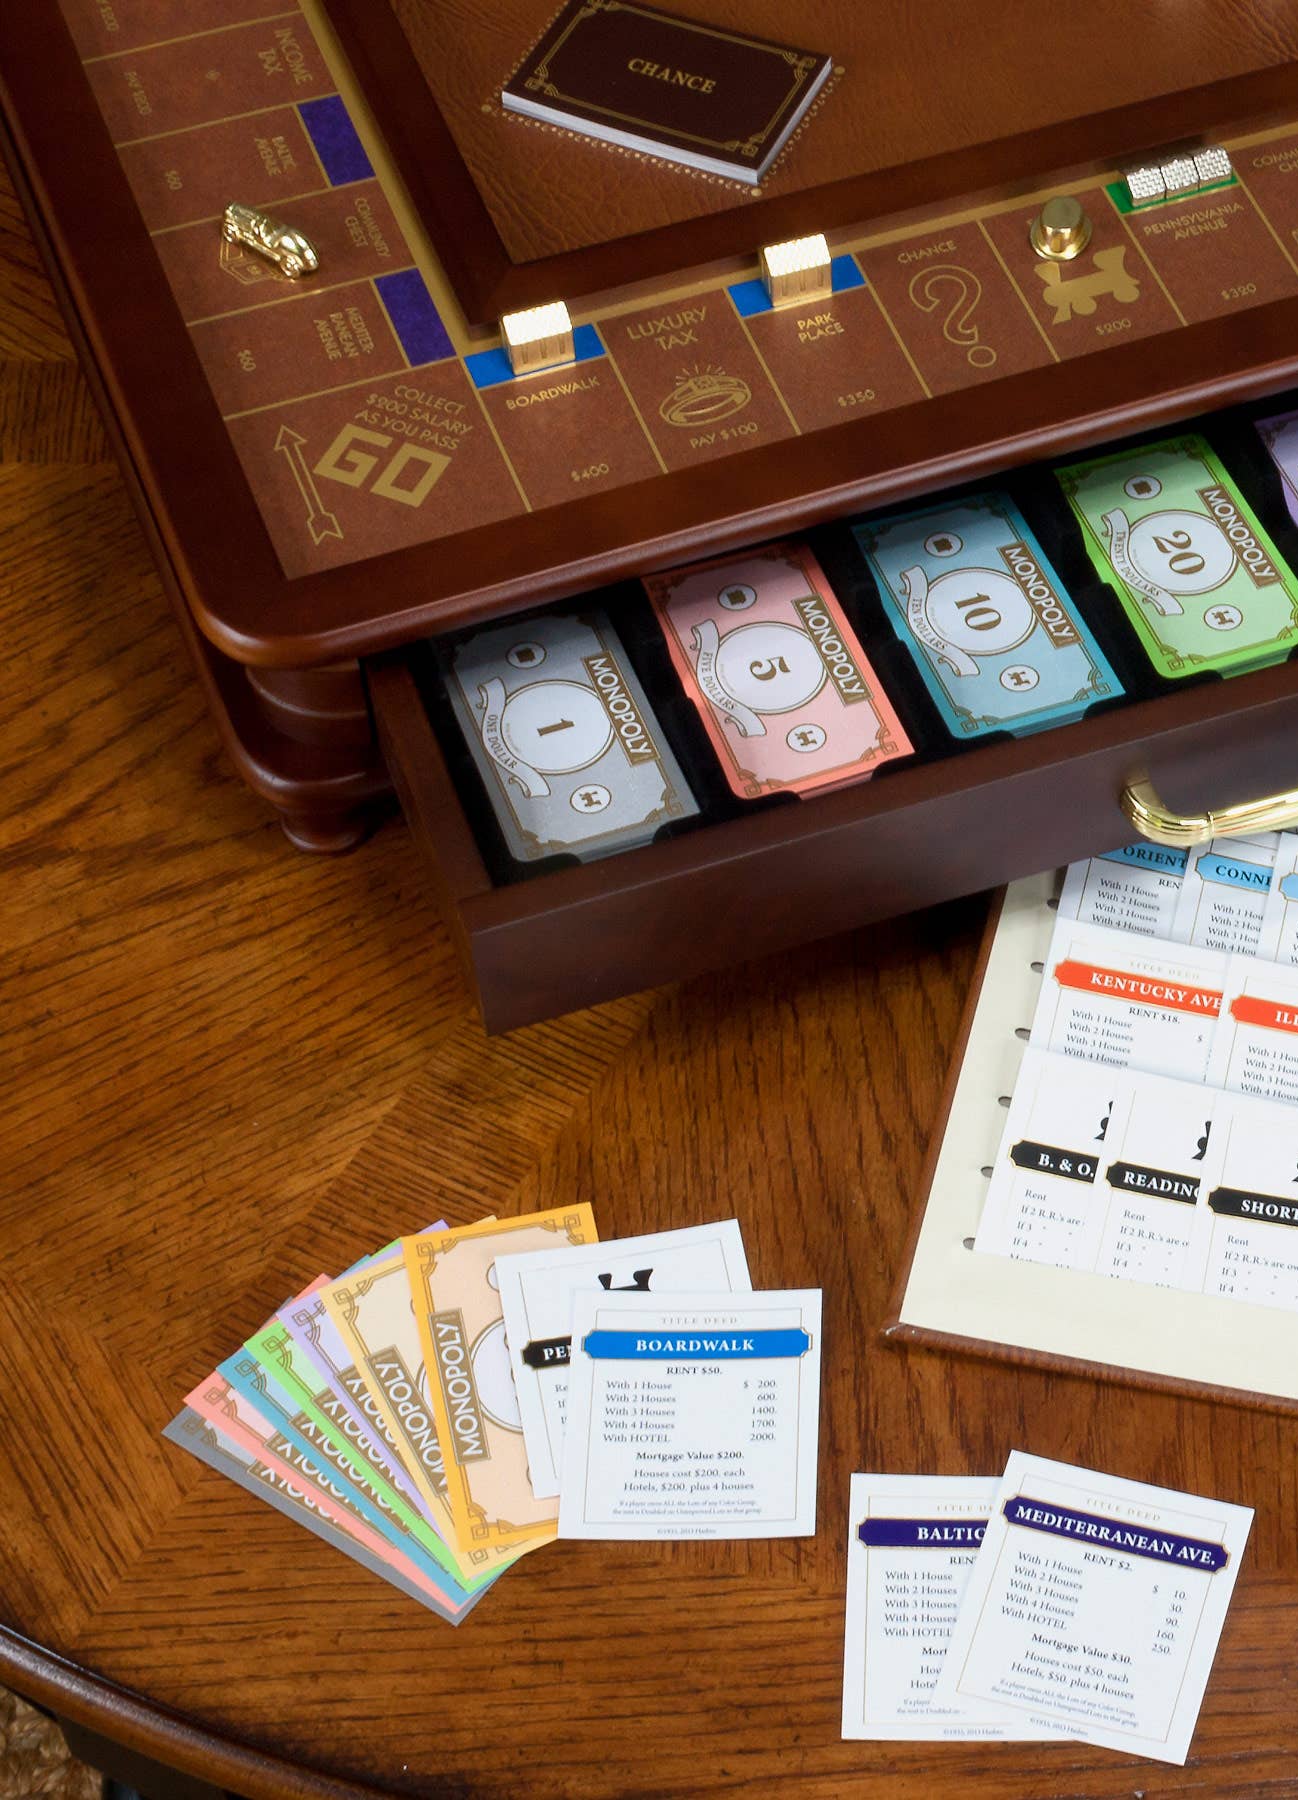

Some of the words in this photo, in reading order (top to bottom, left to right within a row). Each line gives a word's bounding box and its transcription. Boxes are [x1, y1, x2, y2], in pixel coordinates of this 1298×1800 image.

[258, 48, 283, 76] TAX
[274, 27, 312, 84] INCOME
[627, 57, 716, 95] CHANCE
[1143, 202, 1244, 236] PENNSYLVANIA
[1173, 220, 1228, 240] AVENUE
[897, 239, 957, 265] CHANCE
[1220, 283, 1257, 301] $320
[626, 306, 708, 341] LUXURY
[796, 311, 835, 331] PARK
[798, 321, 845, 344] PLACE
[1095, 318, 1132, 336] $200
[655, 329, 698, 351] TAX
[393, 384, 466, 416] COLLECT
[506, 376, 600, 410] BOARDWALK
[837, 389, 876, 408] $350
[366, 393, 407, 416] $200
[411, 407, 473, 435] SALARY
[354, 409, 378, 424] AS
[382, 414, 418, 437] YOU
[419, 429, 460, 450] PASS
[689, 432, 717, 449] PAY
[720, 421, 759, 441] $100
[313, 423, 452, 508] GO
[570, 463, 610, 482] $400
[1204, 489, 1276, 578] MONOPOLY
[1152, 530, 1205, 575] 20
[1005, 547, 1075, 639] MONOPOLY
[954, 592, 1002, 631] 10
[800, 599, 865, 695] MONOPOLY
[750, 656, 791, 681] 5
[589, 657, 651, 754] MONOPOLY
[488, 714, 497, 734] ONE
[536, 718, 575, 736] 1
[488, 736, 518, 769] DOLLAR
[1091, 971, 1188, 1003] KENTUCKY
[1129, 1007, 1159, 1020] RENT
[1038, 1153, 1054, 1169] B.
[1058, 1158, 1072, 1173] &
[636, 1339, 754, 1351] BOARDWALK
[702, 1367, 723, 1375] $50.
[437, 1322, 483, 1457] MONOPOLY
[607, 1381, 630, 1389] With
[603, 1434, 627, 1442] With
[636, 1452, 684, 1462] Mortgage
[717, 1451, 744, 1459] $200.
[1015, 1505, 1174, 1555] MEDITERRANEAN
[1176, 1546, 1216, 1566] AVE.
[1084, 1552, 1116, 1566] RENT
[1032, 1633, 1078, 1652] Mortgage
[1082, 1645, 1109, 1659] Value
